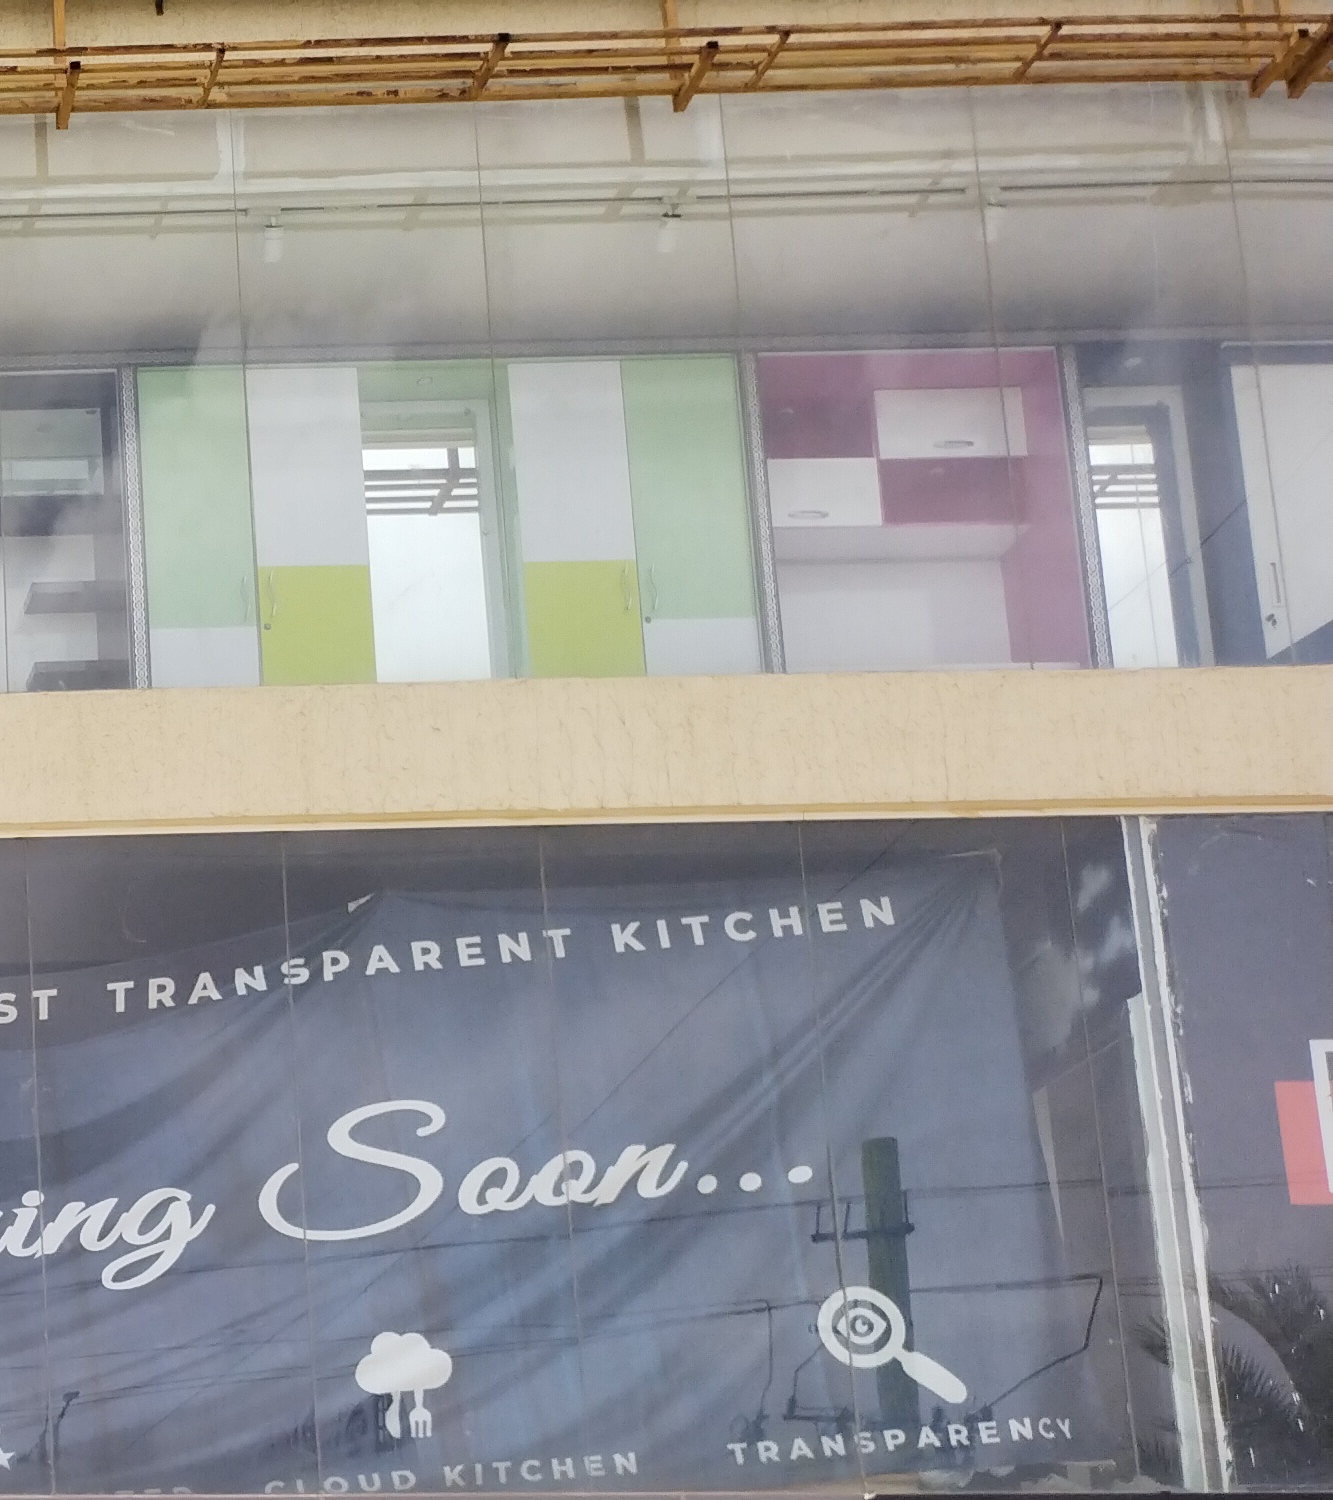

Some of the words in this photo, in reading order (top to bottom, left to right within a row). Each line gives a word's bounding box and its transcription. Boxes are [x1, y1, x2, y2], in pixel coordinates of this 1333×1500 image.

[106, 928, 572, 1013] TRANSPARENT
[612, 895, 896, 954] KITCHEN
[258, 1099, 814, 1241] Soon...
[442, 1451, 640, 1489] KITCHEN
[727, 1416, 1075, 1467] TRANSPARENCY
